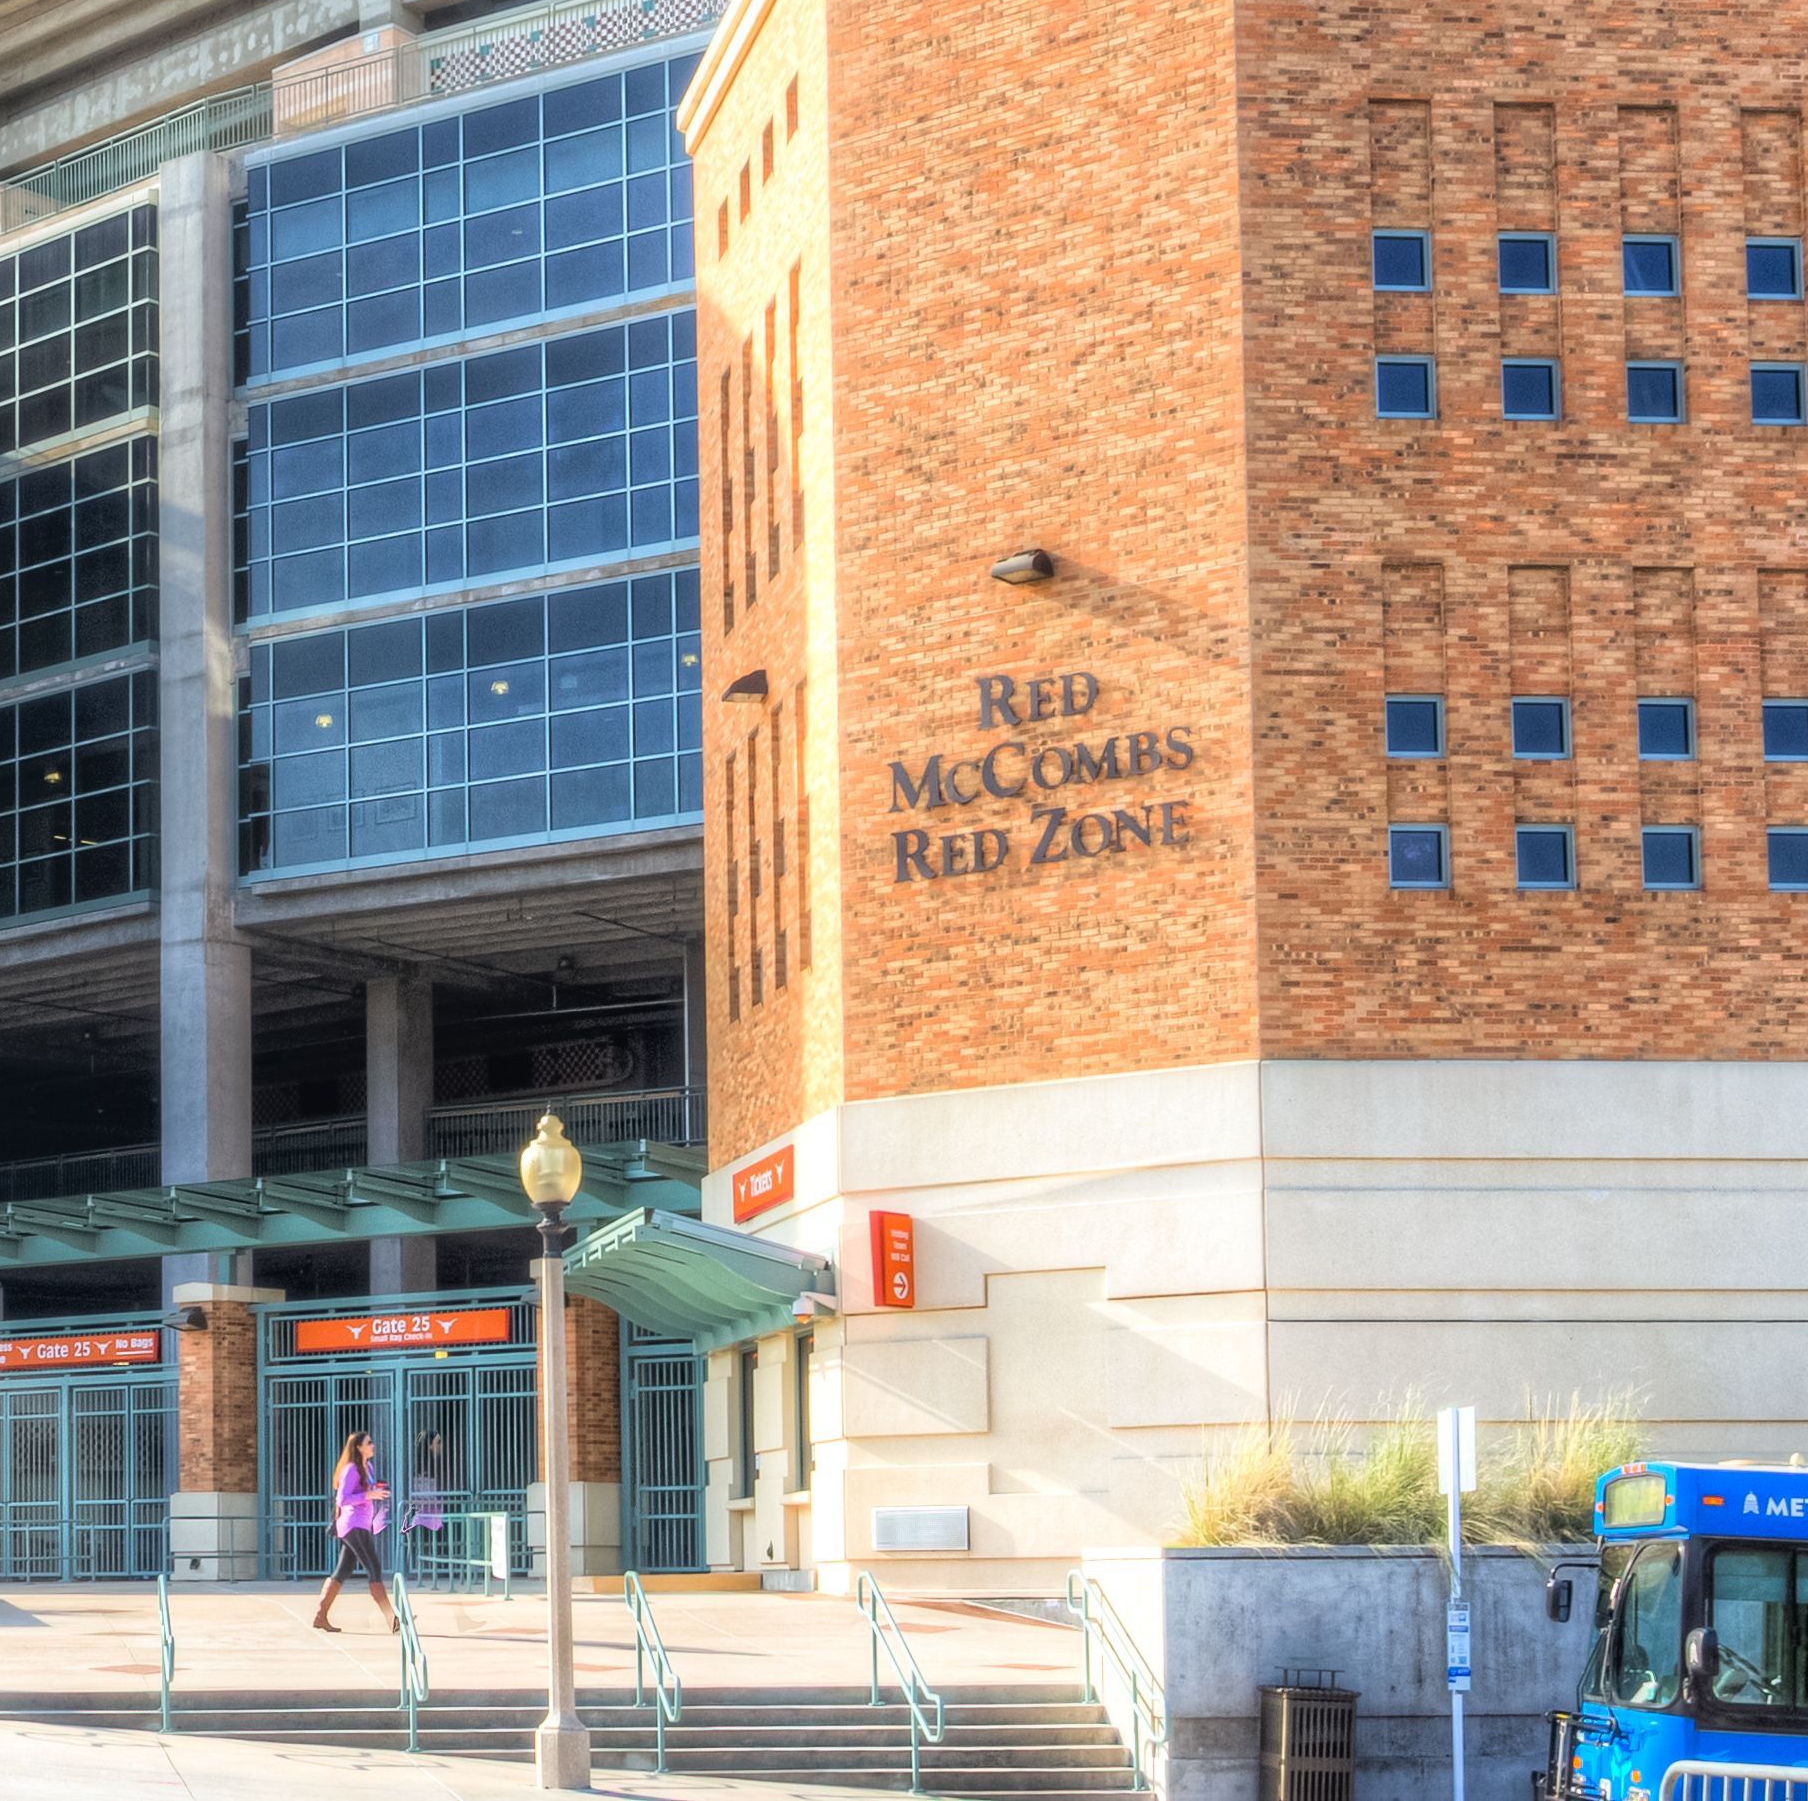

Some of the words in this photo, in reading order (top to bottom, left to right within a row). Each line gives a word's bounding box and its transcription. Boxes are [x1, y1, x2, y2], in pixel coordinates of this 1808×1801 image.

[975, 671, 1100, 731] RED
[890, 828, 1010, 884] RED
[1030, 800, 1190, 865] ZONE
[750, 1168, 773, 1198] Tickets
[372, 1318, 407, 1334] Gate
[412, 1316, 431, 1332] 25
[37, 1343, 69, 1359] Gate
[74, 1341, 91, 1357] 25
[115, 1339, 128, 1349] No
[131, 1337, 154, 1349] Bags
